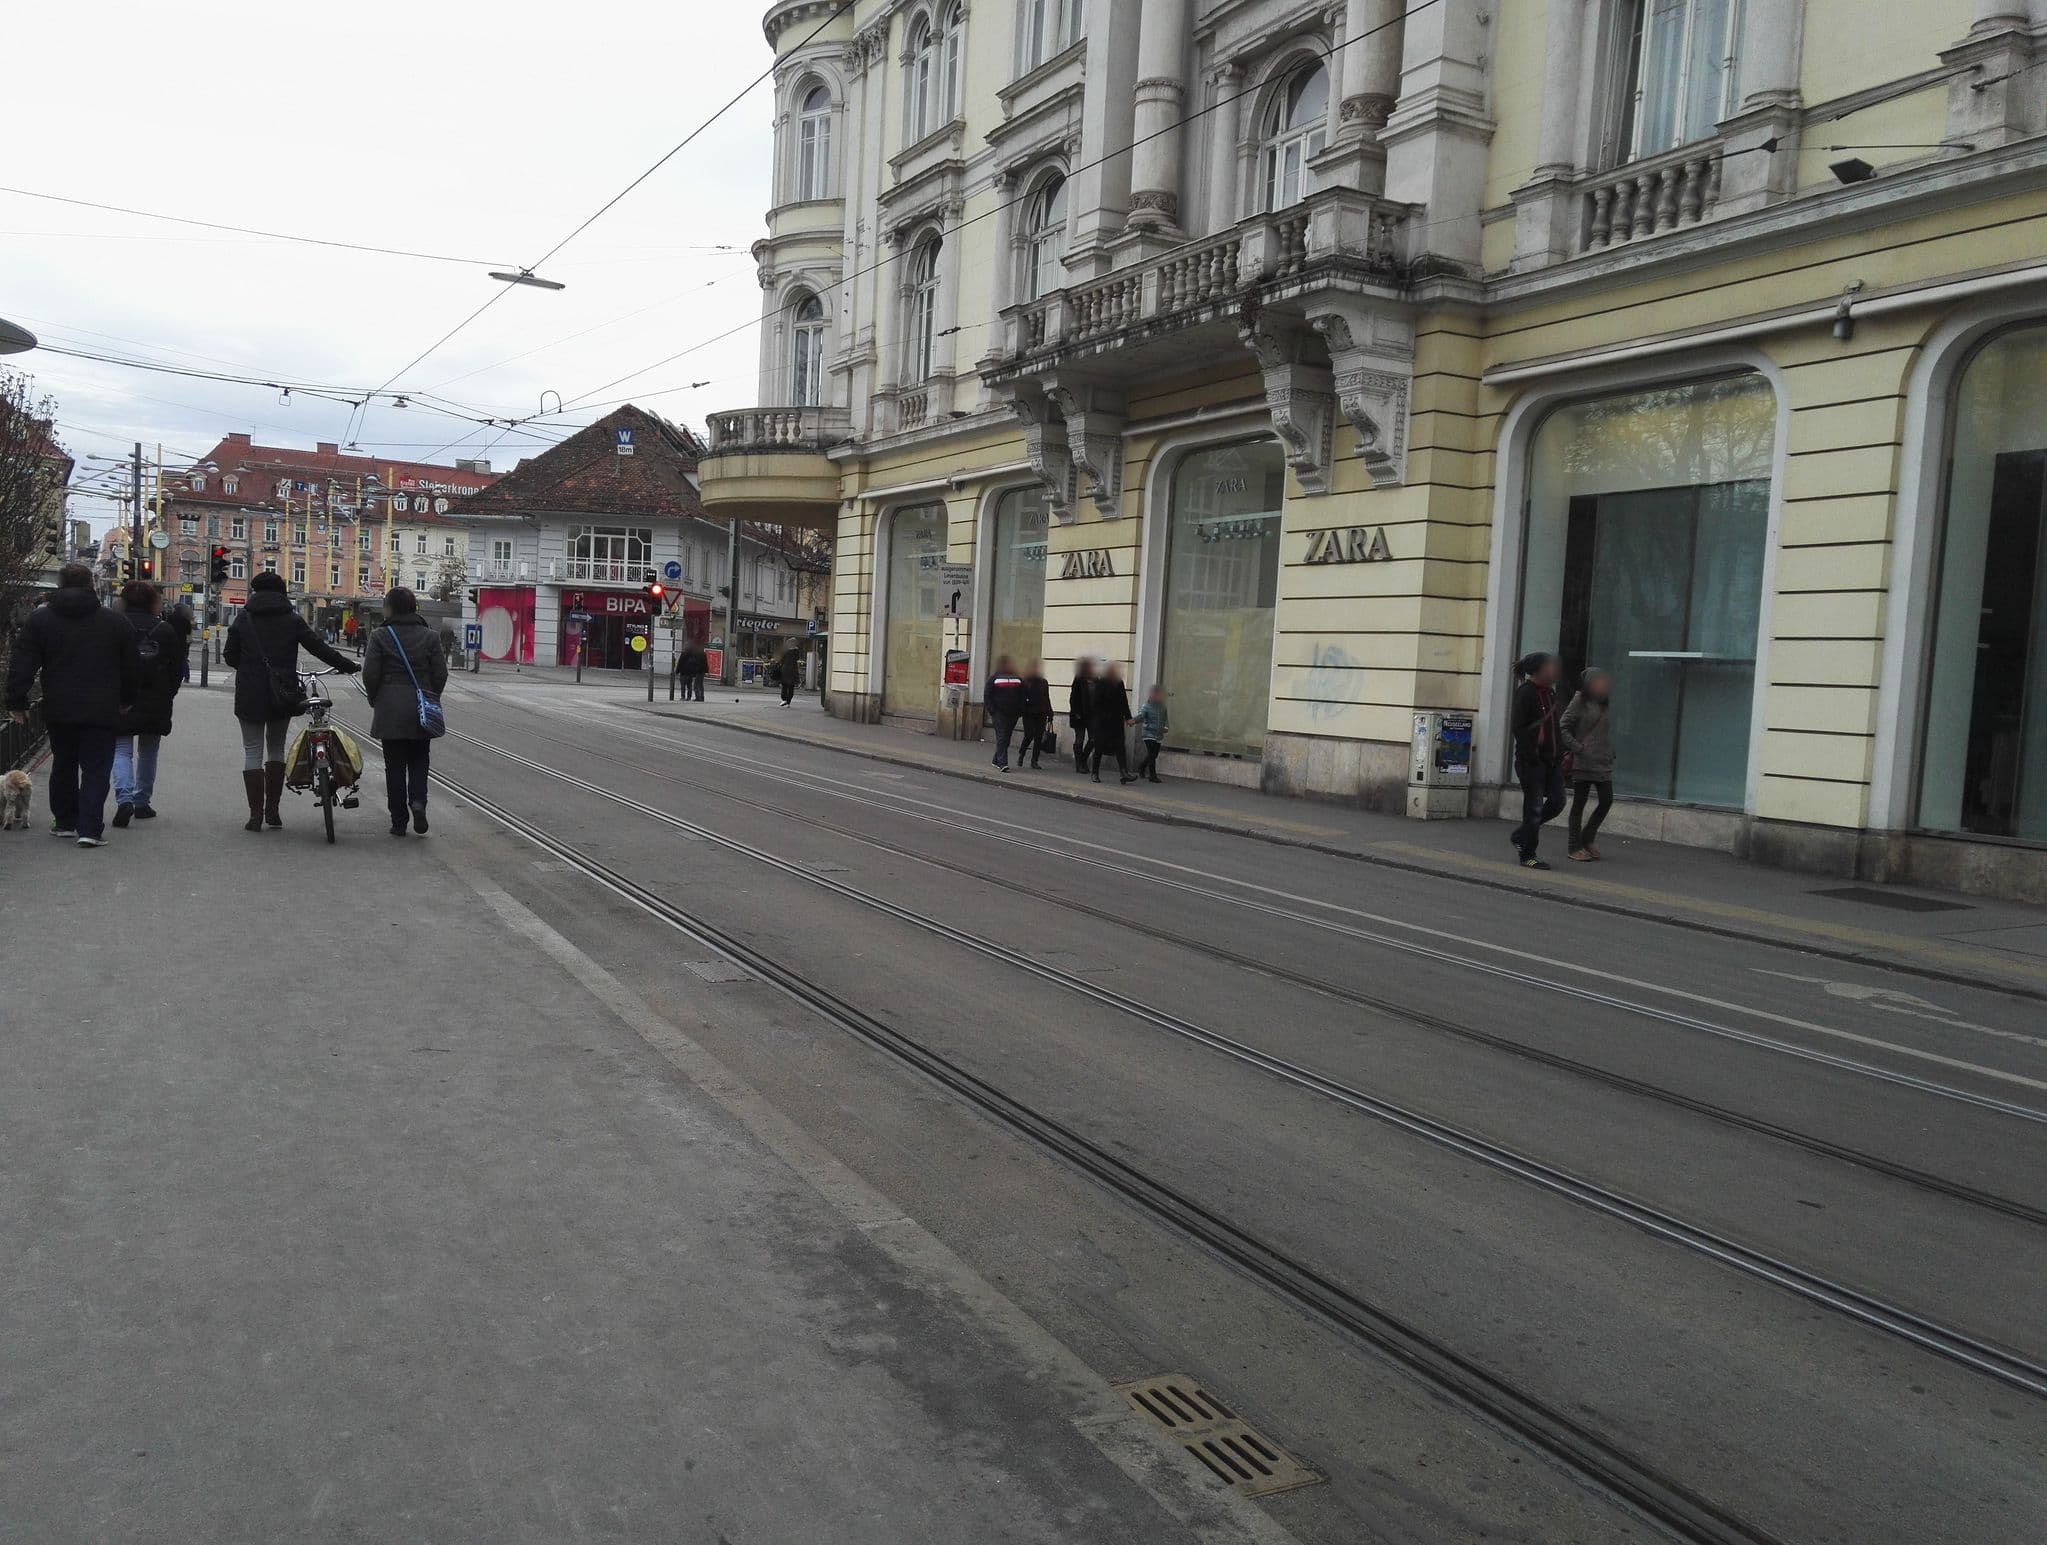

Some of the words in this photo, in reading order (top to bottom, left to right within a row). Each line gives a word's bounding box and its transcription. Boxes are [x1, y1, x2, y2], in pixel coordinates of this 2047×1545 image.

[618, 431, 631, 442] W
[1215, 478, 1248, 494] ZARA
[1303, 526, 1393, 565] ZARA
[1060, 549, 1115, 579] ZARA
[606, 597, 647, 614] BIPA
